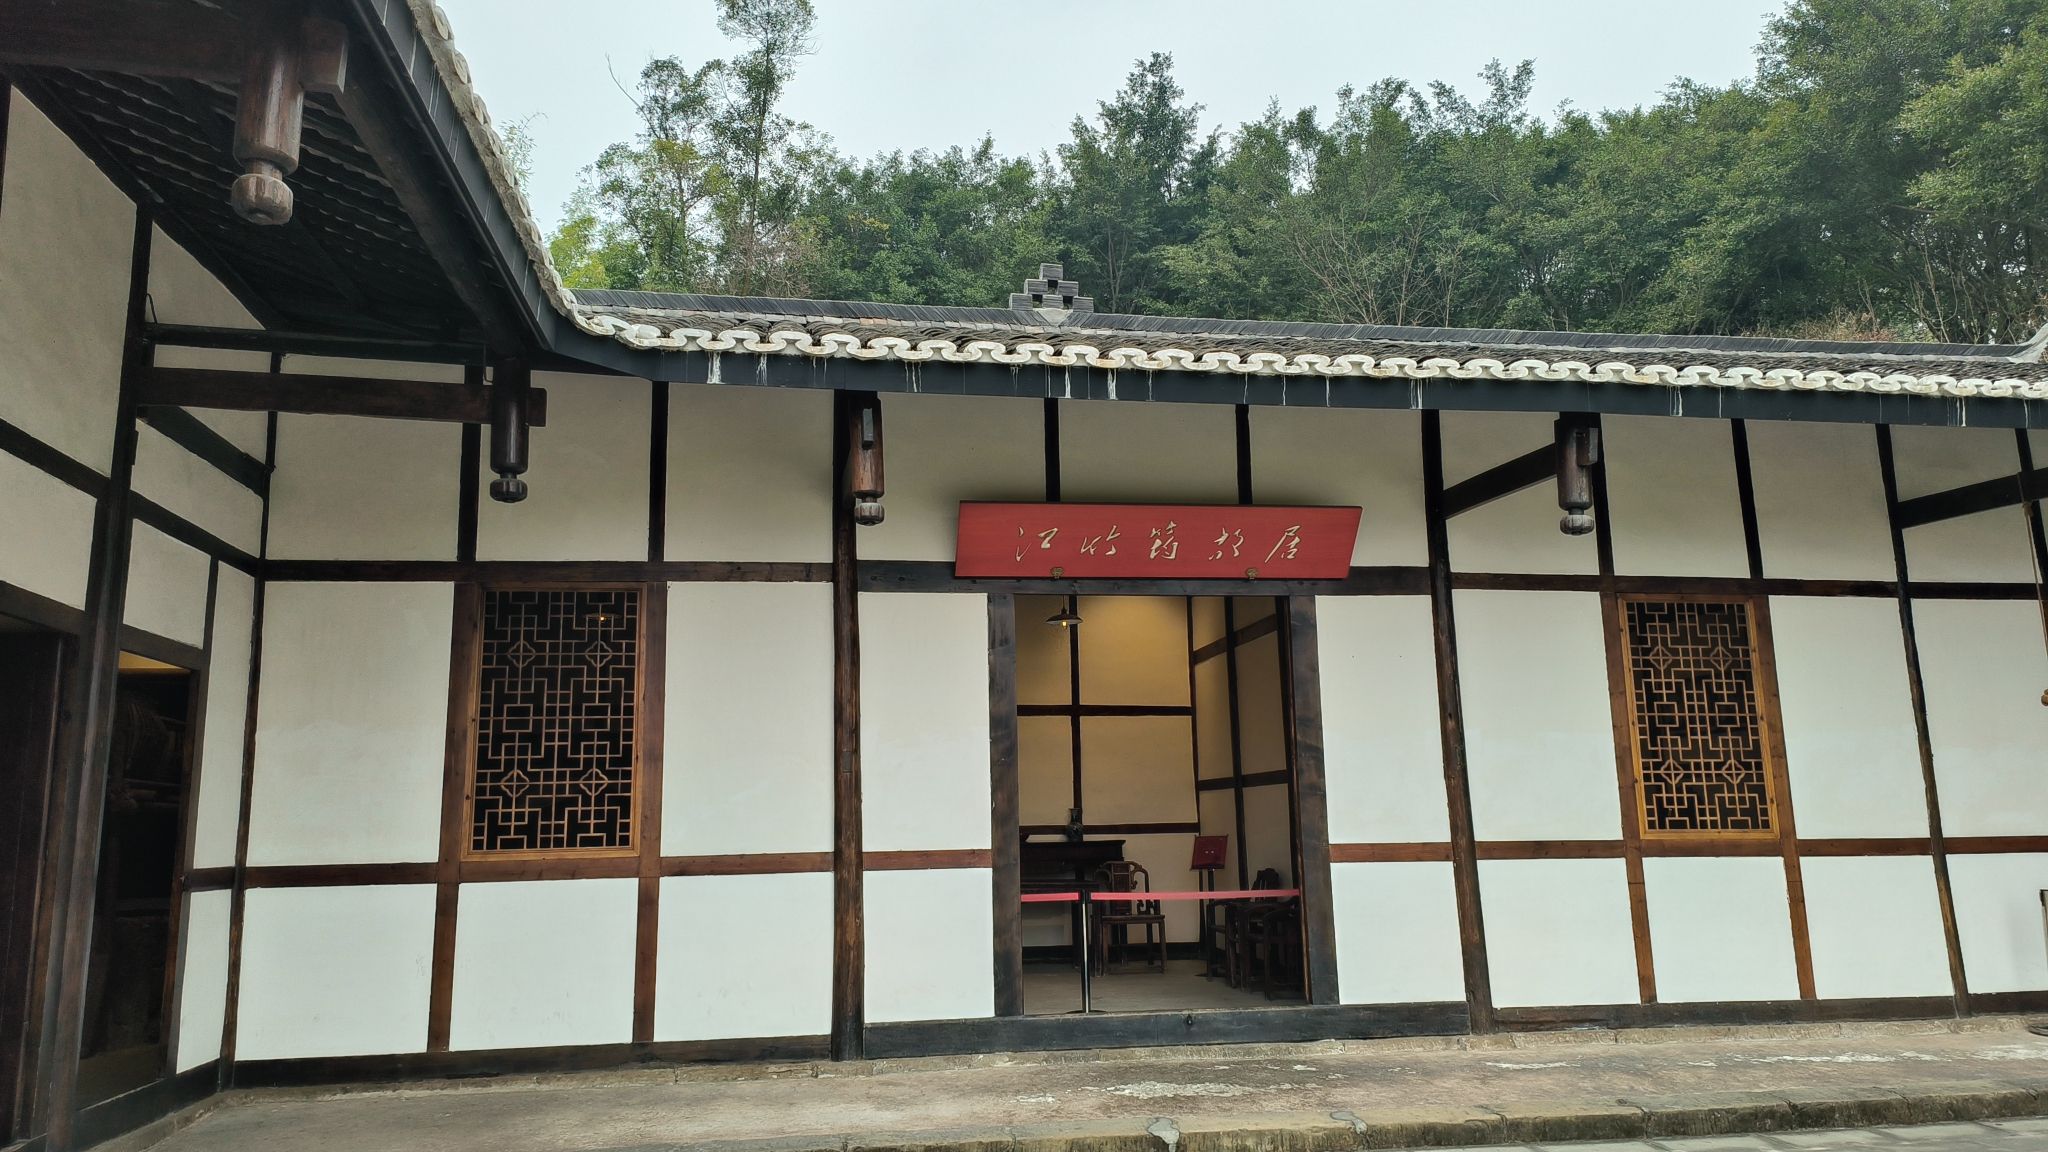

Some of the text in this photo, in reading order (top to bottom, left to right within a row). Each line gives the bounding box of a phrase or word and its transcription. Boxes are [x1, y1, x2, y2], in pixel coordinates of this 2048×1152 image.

[1015, 520, 1301, 563] 江竹筠故居
